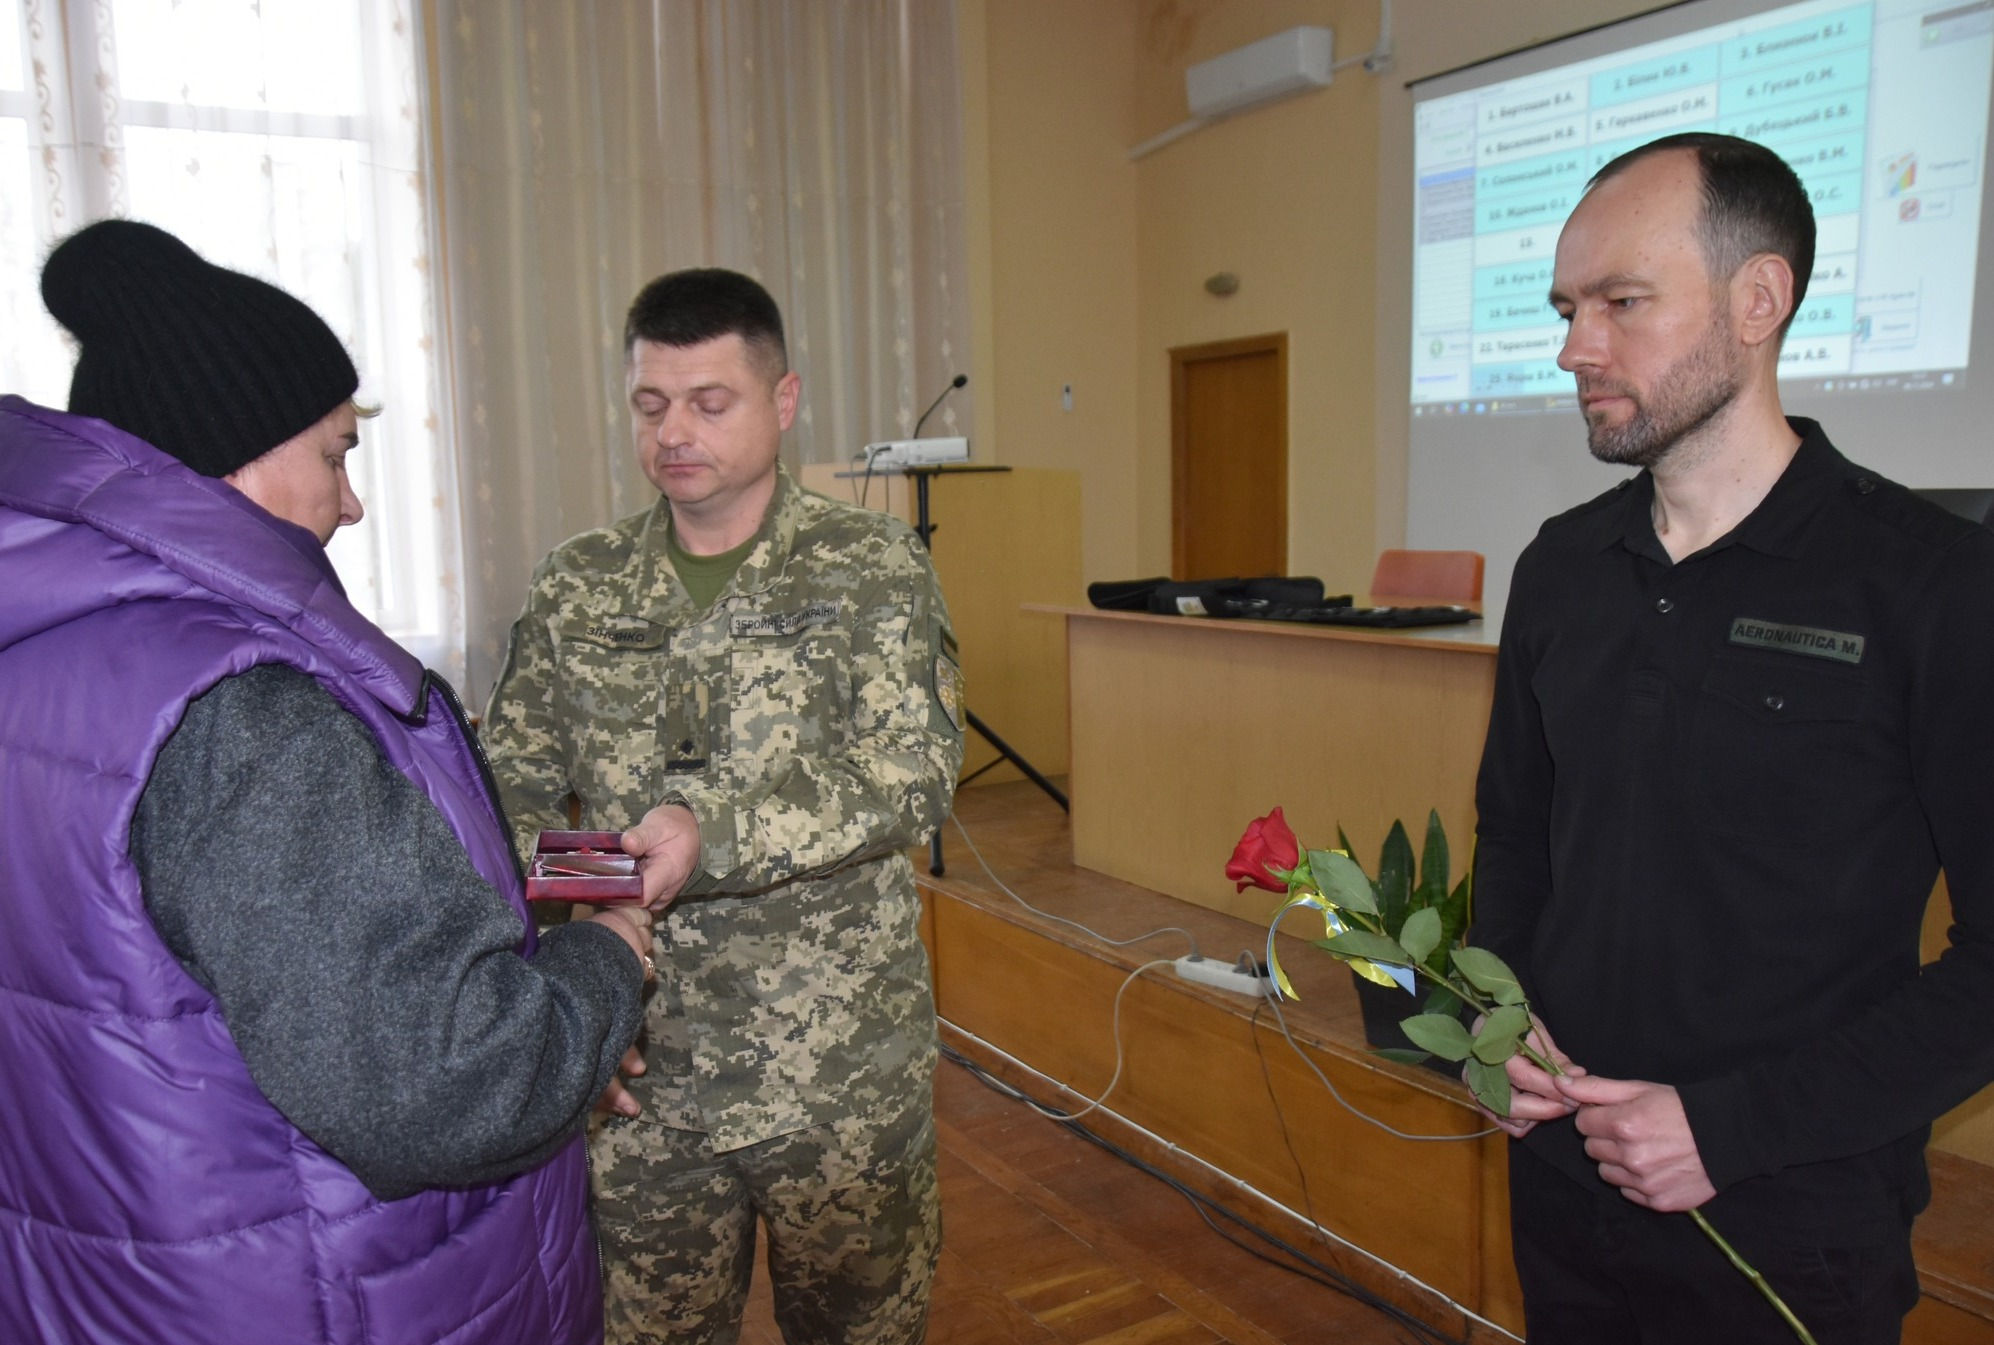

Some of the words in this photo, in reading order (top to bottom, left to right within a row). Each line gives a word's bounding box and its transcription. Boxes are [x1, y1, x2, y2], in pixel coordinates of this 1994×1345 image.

[734, 618, 777, 630] ЗБРОЙНІ
[801, 605, 837, 621] УКРАЇНИ
[586, 626, 646, 643] ЗІНЧЕНКО
[1734, 622, 1836, 651] AERONAUTICA
[1841, 639, 1861, 657] M.
